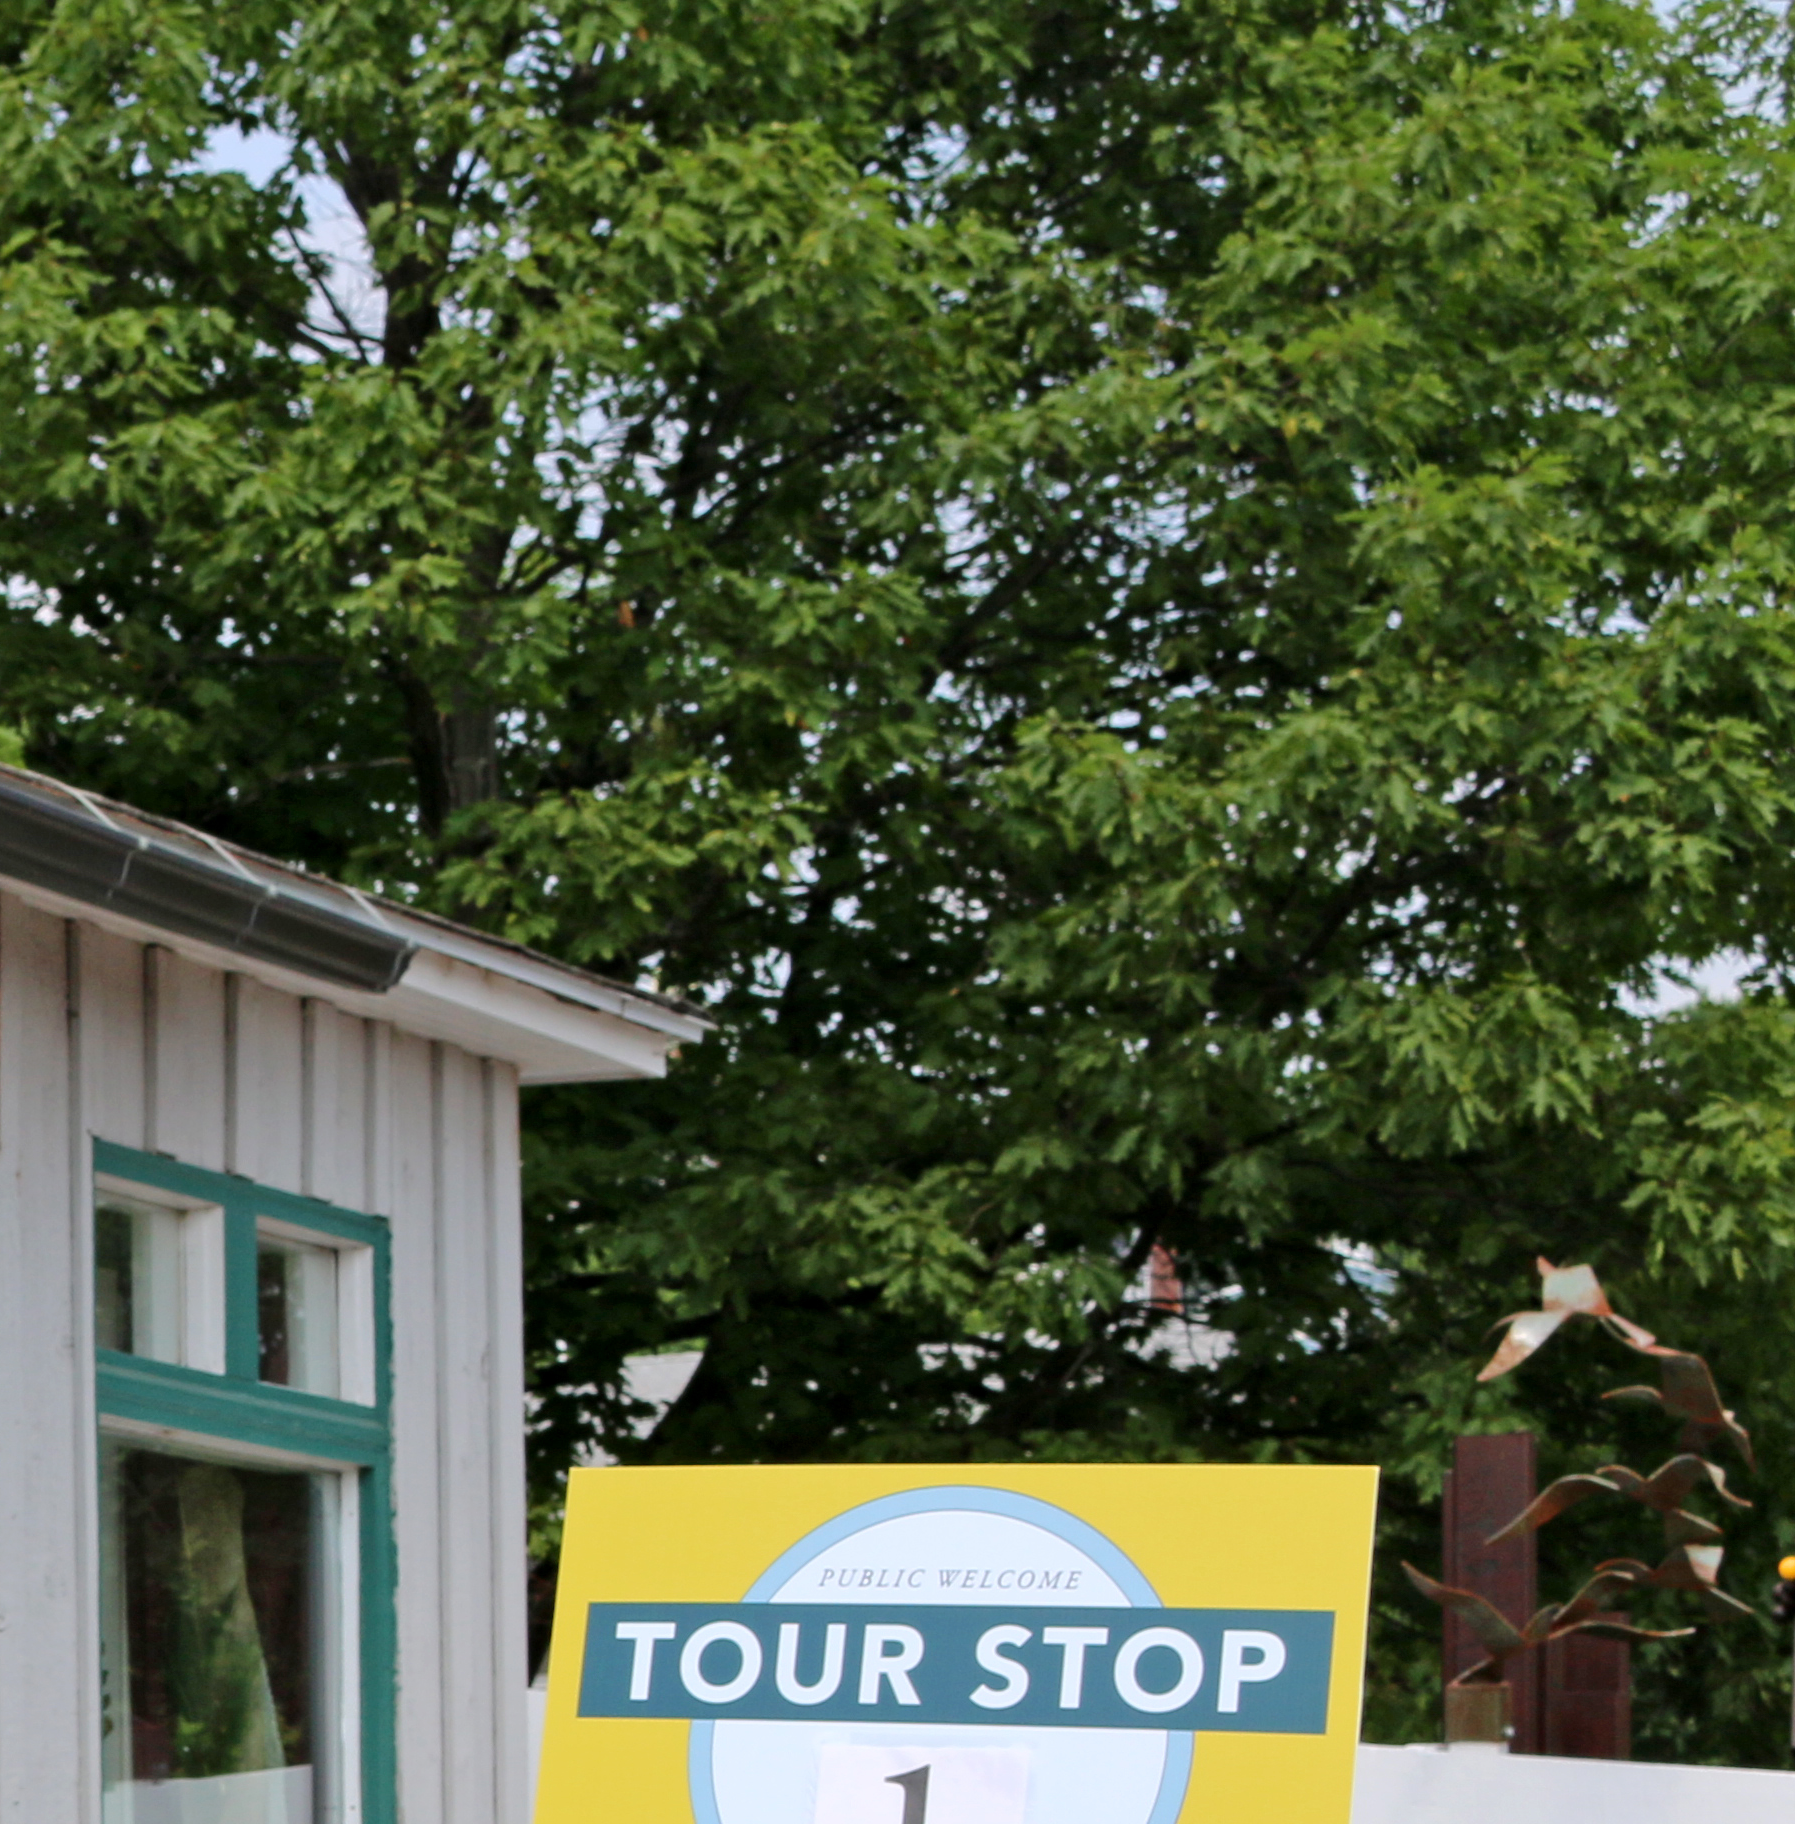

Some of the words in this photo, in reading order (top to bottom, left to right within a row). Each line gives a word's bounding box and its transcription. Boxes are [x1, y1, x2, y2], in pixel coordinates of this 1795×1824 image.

[818, 1568, 926, 1589] PUBLIC
[938, 1569, 1083, 1591] WELCOME
[615, 1620, 926, 1706] TOUR
[969, 1624, 1288, 1714] STOP
